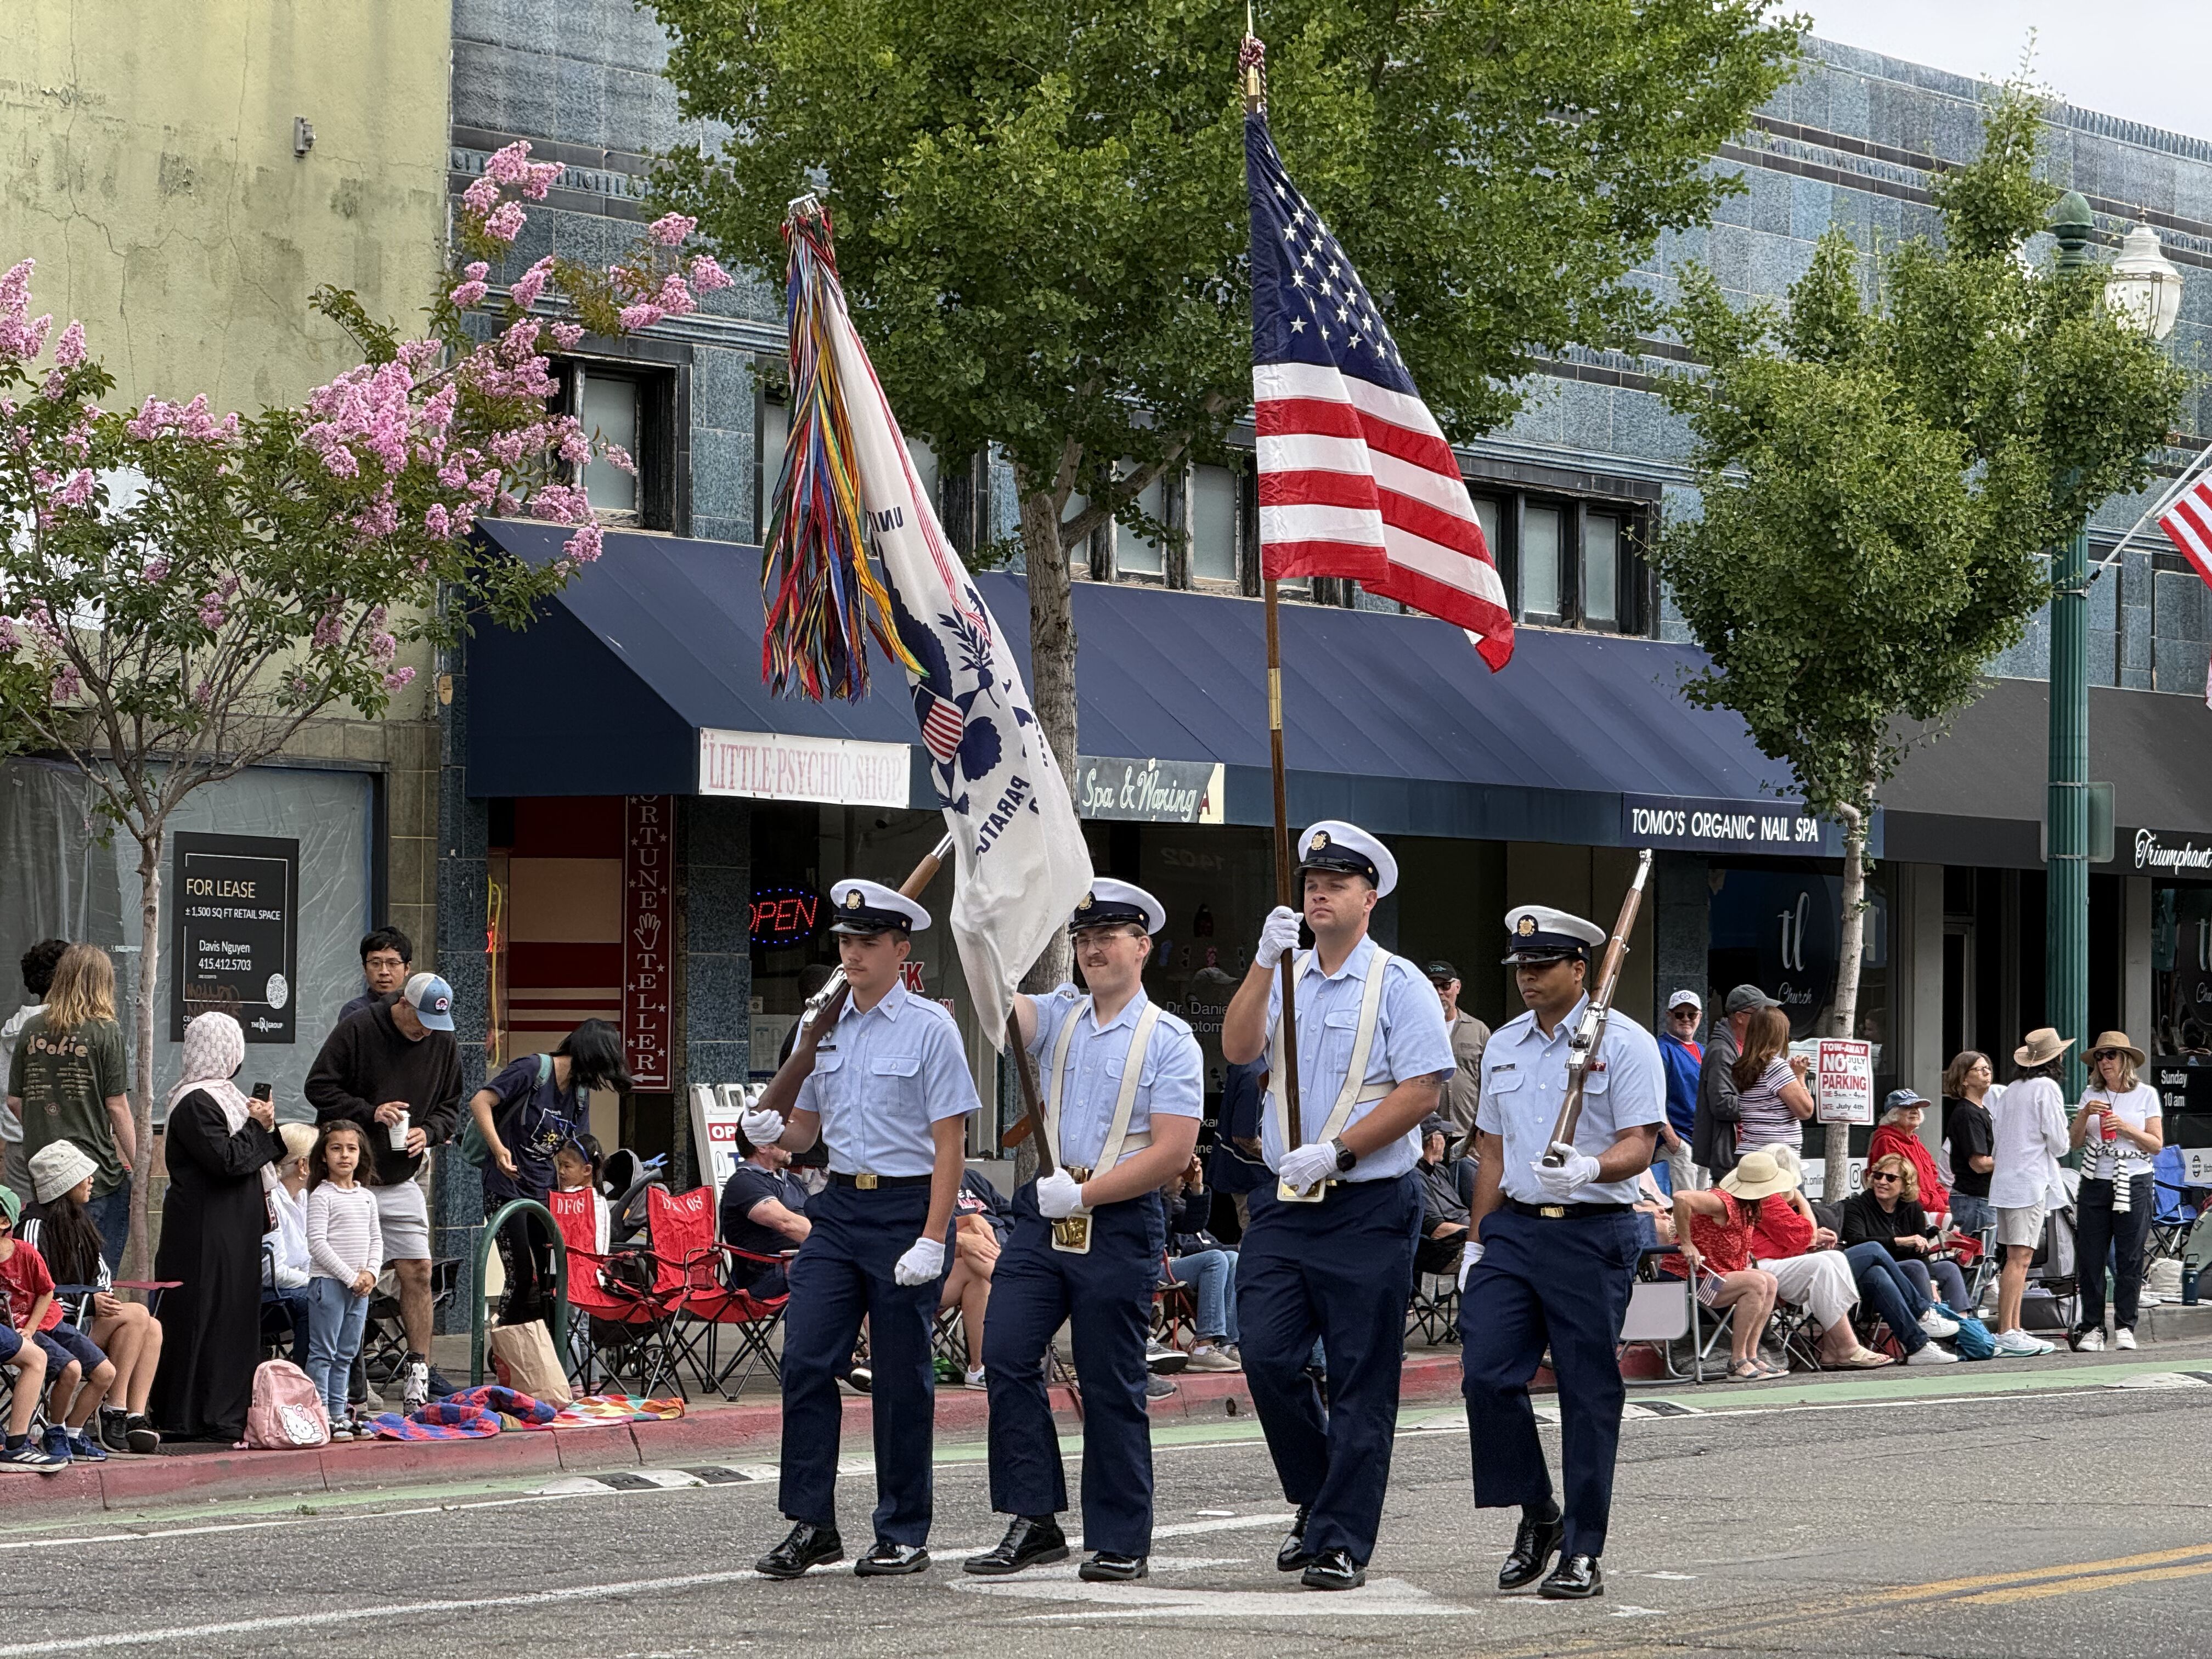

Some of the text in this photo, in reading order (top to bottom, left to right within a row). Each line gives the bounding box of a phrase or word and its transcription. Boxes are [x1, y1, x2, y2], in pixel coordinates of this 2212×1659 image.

[708, 742, 901, 801] LITTLE PSYCHIC SHOP
[1082, 766, 1198, 822] Spa & Waxing
[1633, 809, 1819, 842] TOMO'S ORGANIC NAIL SPA
[2135, 829, 2212, 875] Triumphant
[186, 878, 256, 899] FOR LEASE
[191, 907, 211, 917] 1,500
[212, 907, 222, 919] SQ
[223, 909, 233, 918] FT
[234, 909, 258, 919] RETAIL
[258, 910, 281, 921] SPACE
[199, 940, 251, 955] Davis Nguyen
[198, 958, 252, 971] 415.412.5703
[635, 953, 657, 1071] TELLER
[1166, 1001, 1184, 1014] Dr.
[27, 1034, 88, 1057] dookie
[1822, 1053, 1847, 1072] NO
[1822, 1074, 1866, 1090] PARKING
[2161, 1070, 2188, 1087] Sunday
[2164, 1092, 2186, 1107] 10 am
[712, 1125, 737, 1139] OP
